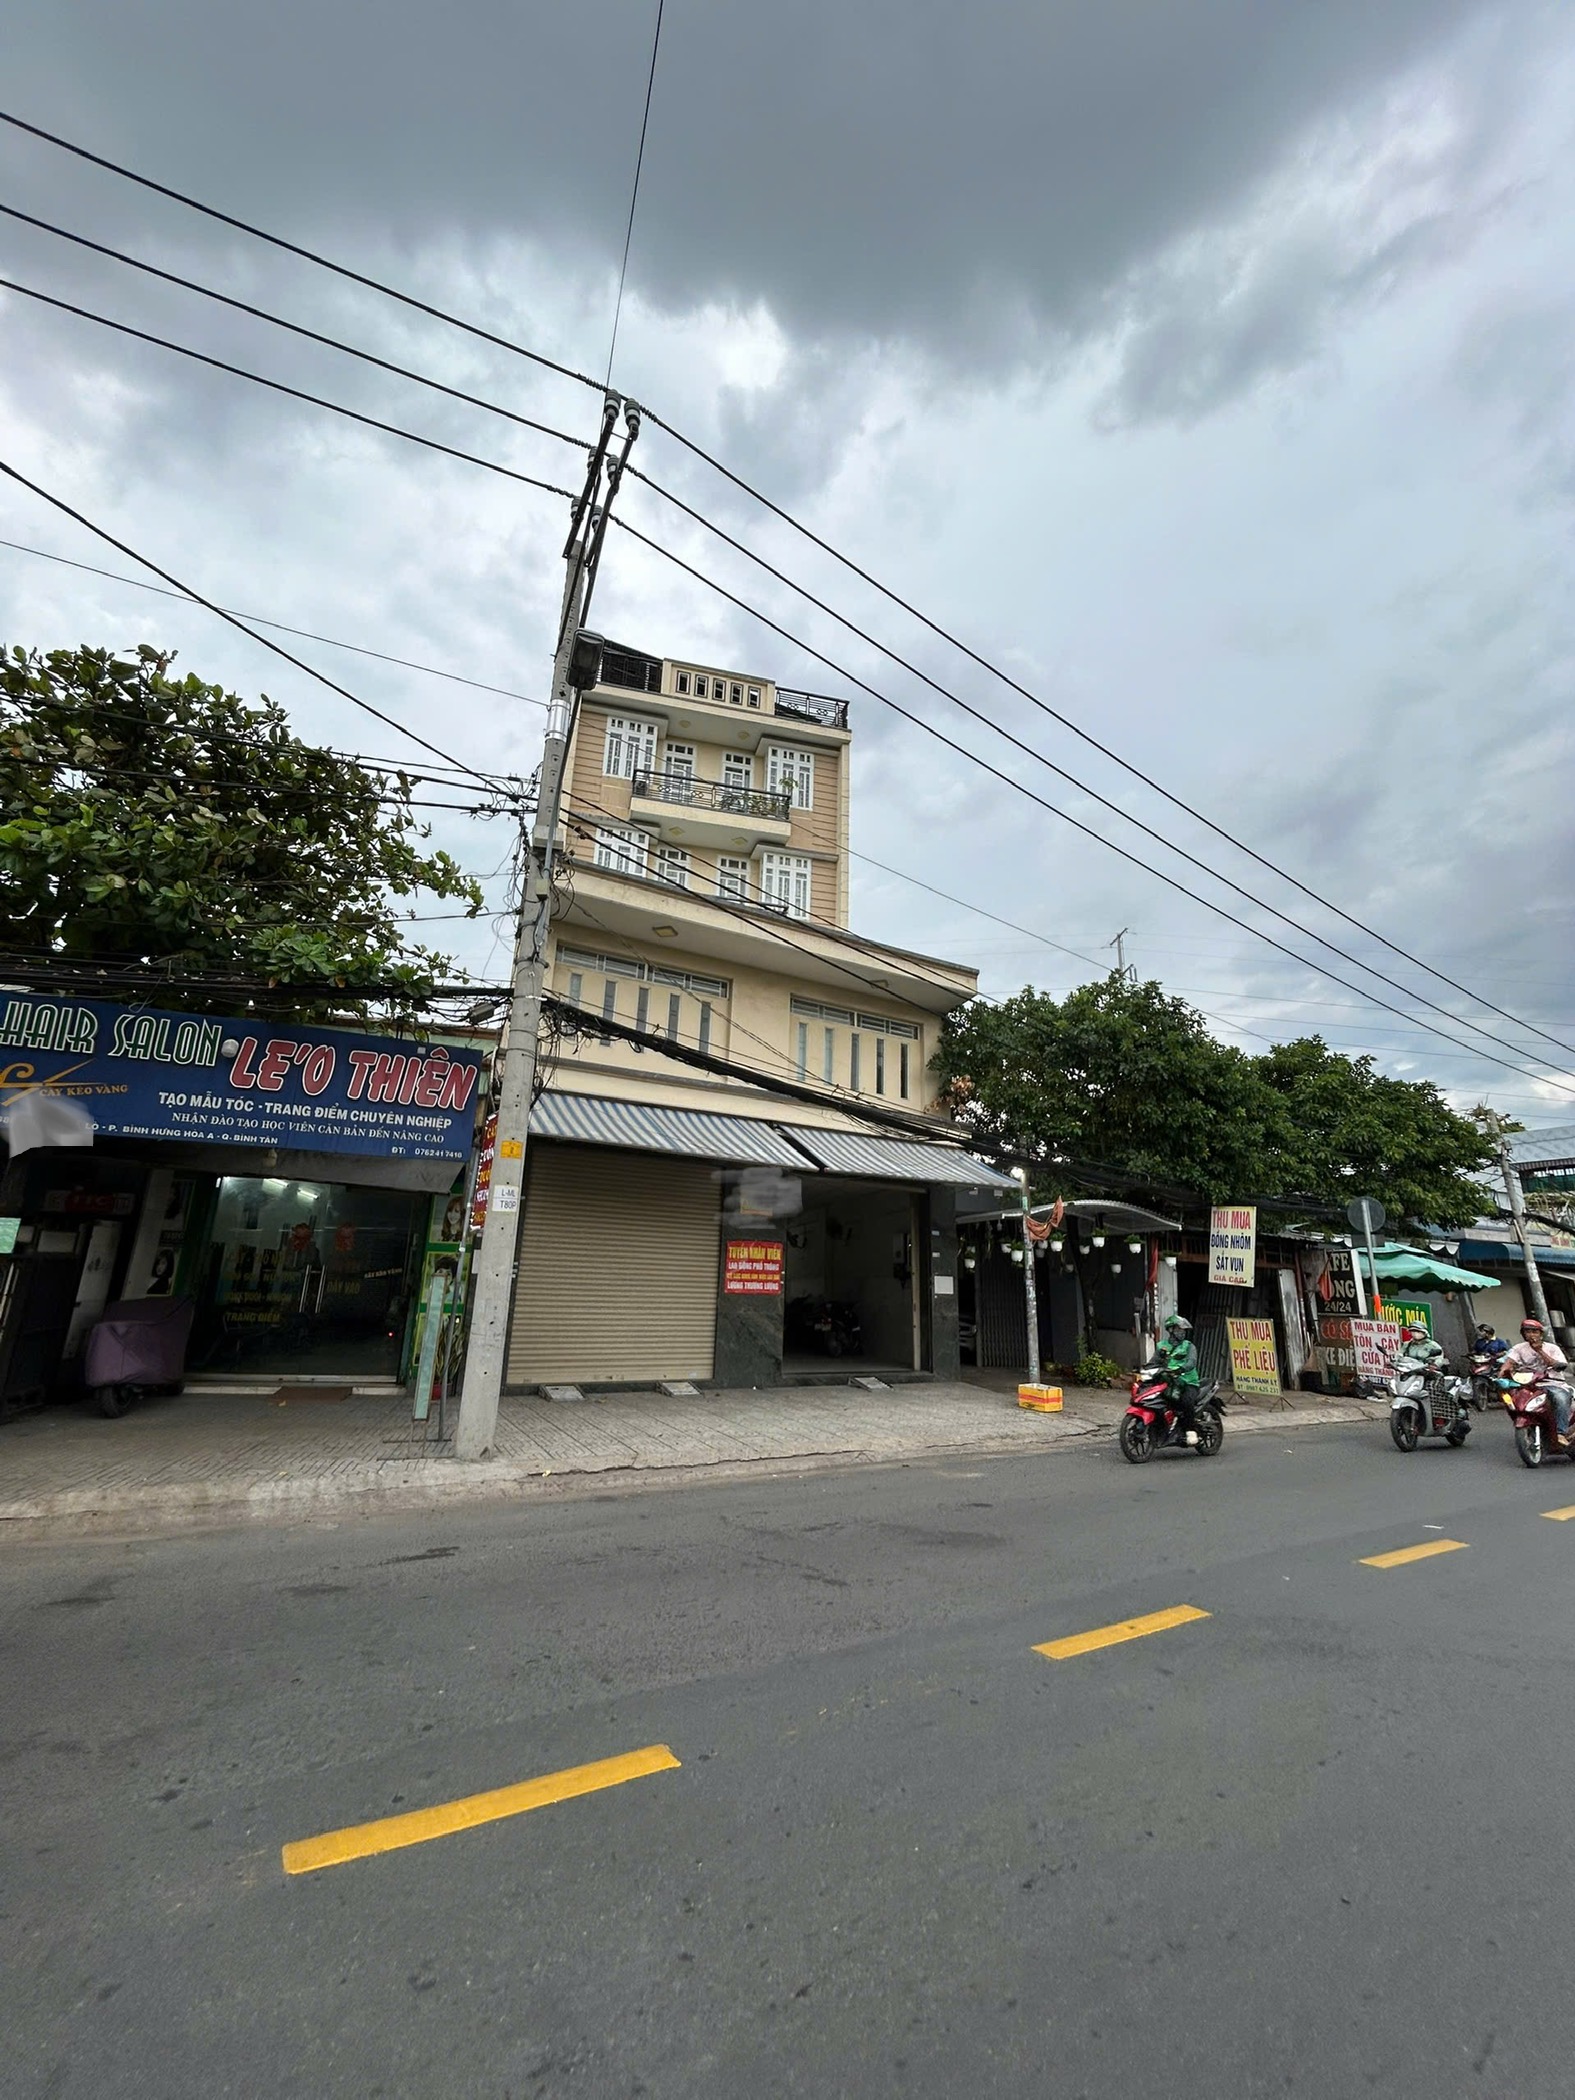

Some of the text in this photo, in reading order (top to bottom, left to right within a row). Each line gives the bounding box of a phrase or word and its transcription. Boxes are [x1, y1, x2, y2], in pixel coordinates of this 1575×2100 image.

[0, 1001, 222, 1067] HAIR SALON
[347, 1047, 478, 1111] THIÊN
[159, 1090, 452, 1131] TẠO MẪU TÓC TRANG ĐIỂM CHUYÊN NGHIỆP
[108, 1124, 117, 1132] P.
[123, 1123, 149, 1134] BÌNH
[151, 1128, 181, 1137] HƯNG
[184, 1129, 204, 1139] HÒA
[234, 1134, 257, 1143] BÌNH
[172, 1111, 444, 1143] NHẬN ĐÀO TẠO HỌC VIÊN CĂN BẢN ĐẾN NÂNG CAO
[1213, 1211, 1250, 1229] THU MUA
[1230, 1233, 1251, 1250] NHÔM
[1230, 1257, 1244, 1275] VỤN
[1324, 1301, 1352, 1312] 24/24
[1405, 1305, 1428, 1328] MÍA
[1230, 1321, 1272, 1341] THU MUA
[1354, 1321, 1374, 1332] MUA
[1354, 1333, 1372, 1348] TÔN
[1233, 1343, 1275, 1374] PHẾ LIỆU
[1338, 1345, 1356, 1370] ĐIỆ
